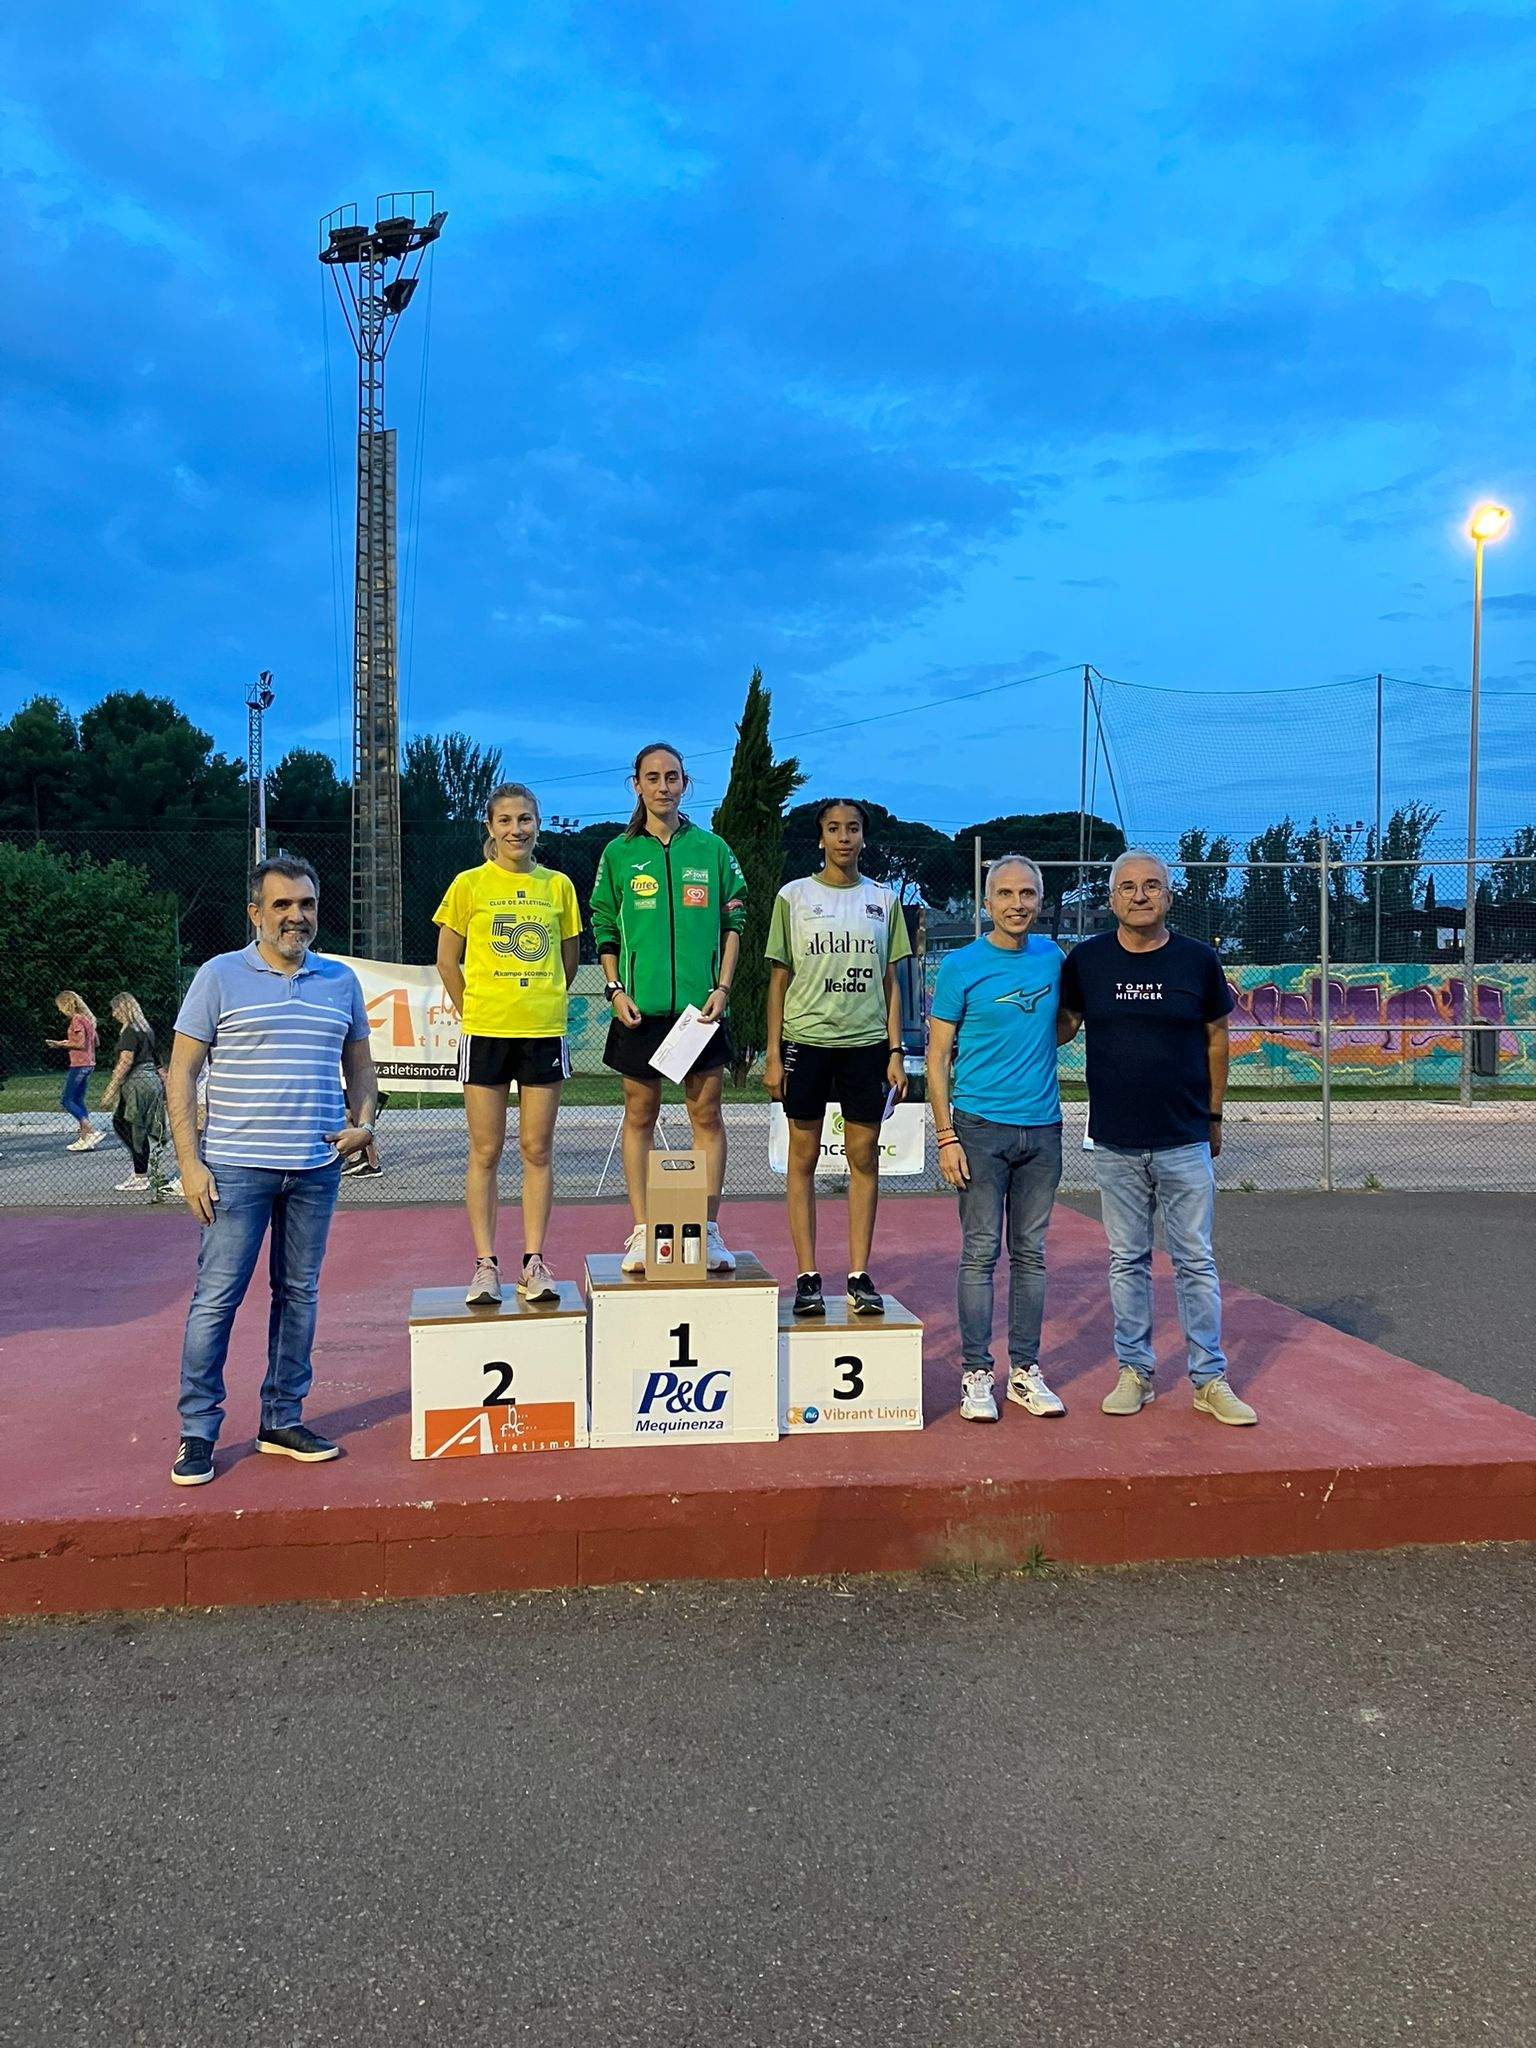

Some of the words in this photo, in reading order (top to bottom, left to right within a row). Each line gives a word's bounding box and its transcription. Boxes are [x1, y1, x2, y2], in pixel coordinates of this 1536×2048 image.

[492, 914, 550, 962] 50
[805, 931, 879, 956] aldahra
[847, 967, 873, 978] ara
[1116, 992, 1163, 1000] HILFIGER
[670, 1323, 698, 1367] 1
[483, 1361, 516, 1407] 2
[637, 1370, 731, 1414] P&G
[833, 1355, 864, 1400] 3
[636, 1419, 724, 1434] Mequinenza
[823, 1408, 873, 1420] Vibrant
[877, 1406, 917, 1421] Living
